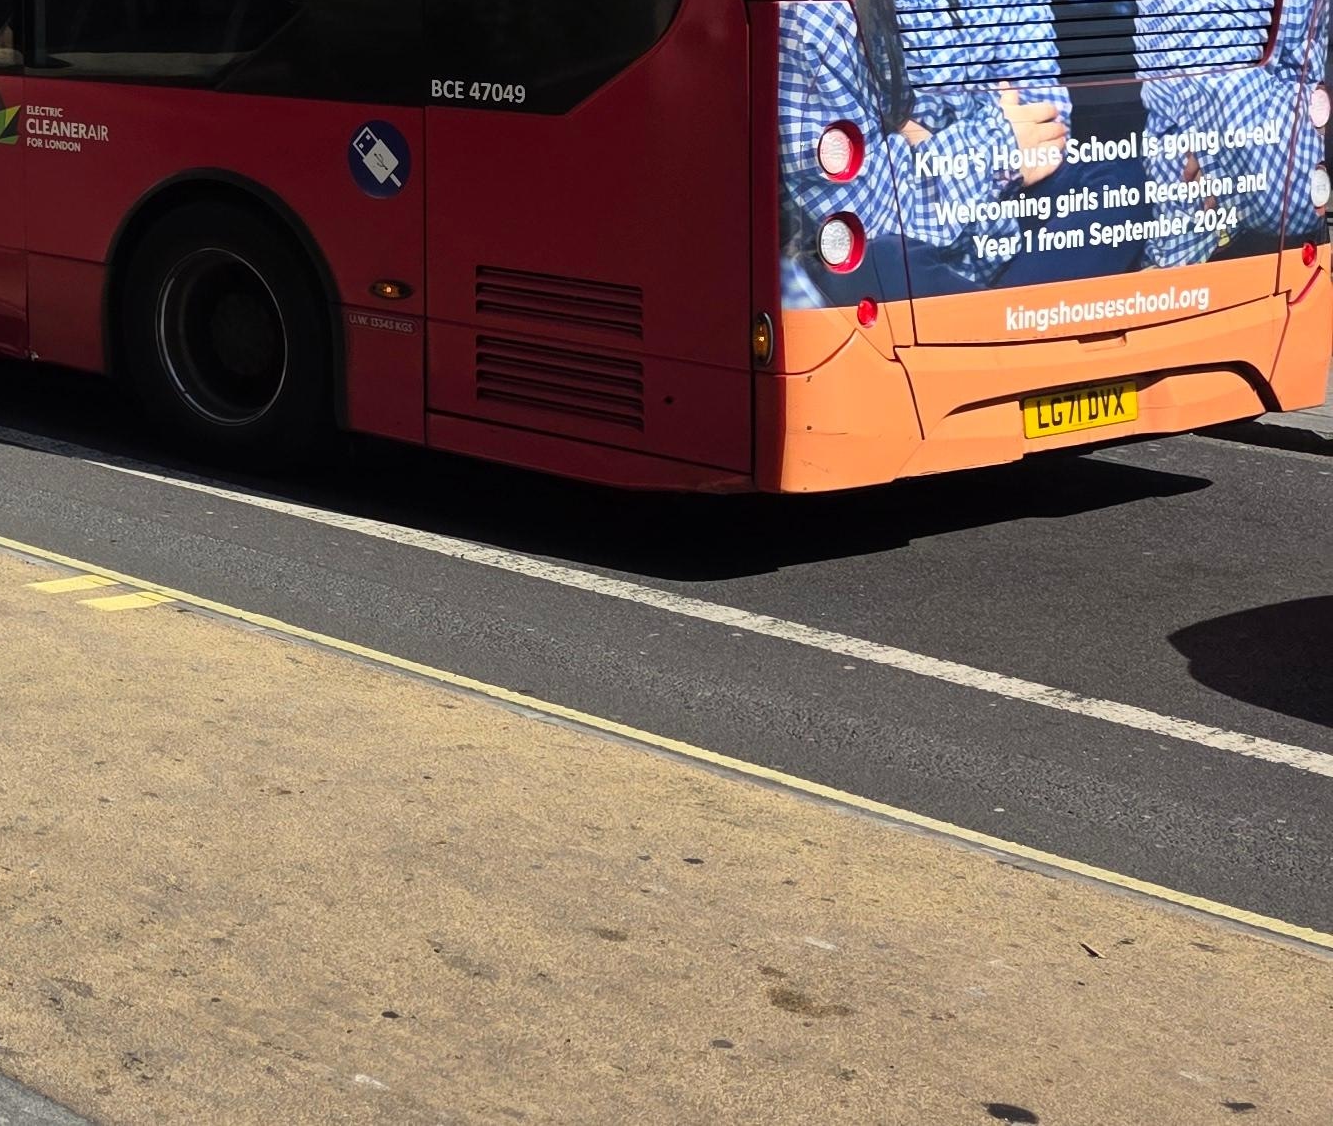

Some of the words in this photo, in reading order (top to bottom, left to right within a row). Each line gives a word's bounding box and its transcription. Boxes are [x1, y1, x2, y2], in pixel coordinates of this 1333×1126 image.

[26, 105, 64, 118] ELECTRIC
[431, 79, 465, 100] BCE
[469, 81, 527, 104] 47049
[26, 136, 43, 149] FOR
[44, 138, 82, 153] LONDON
[914, 143, 986, 178] King's
[992, 145, 1062, 173] House
[1066, 132, 1137, 163] School
[1141, 131, 1160, 156] is
[1164, 126, 1220, 160] going
[1223, 119, 1281, 148] co-ed!
[935, 191, 1052, 226] Welcoming
[1056, 186, 1099, 219] girls
[1102, 183, 1141, 210] into
[1144, 173, 1233, 207] Reception
[1236, 171, 1267, 194] and
[973, 231, 1022, 259] Year
[1024, 229, 1033, 254] 1
[1037, 224, 1085, 251] from
[1089, 212, 1191, 249] September
[1193, 207, 1239, 235] 2024
[1005, 287, 1210, 332] kingshouseschool.org
[1036, 393, 1083, 430] LG71
[1088, 385, 1126, 421] DVX
